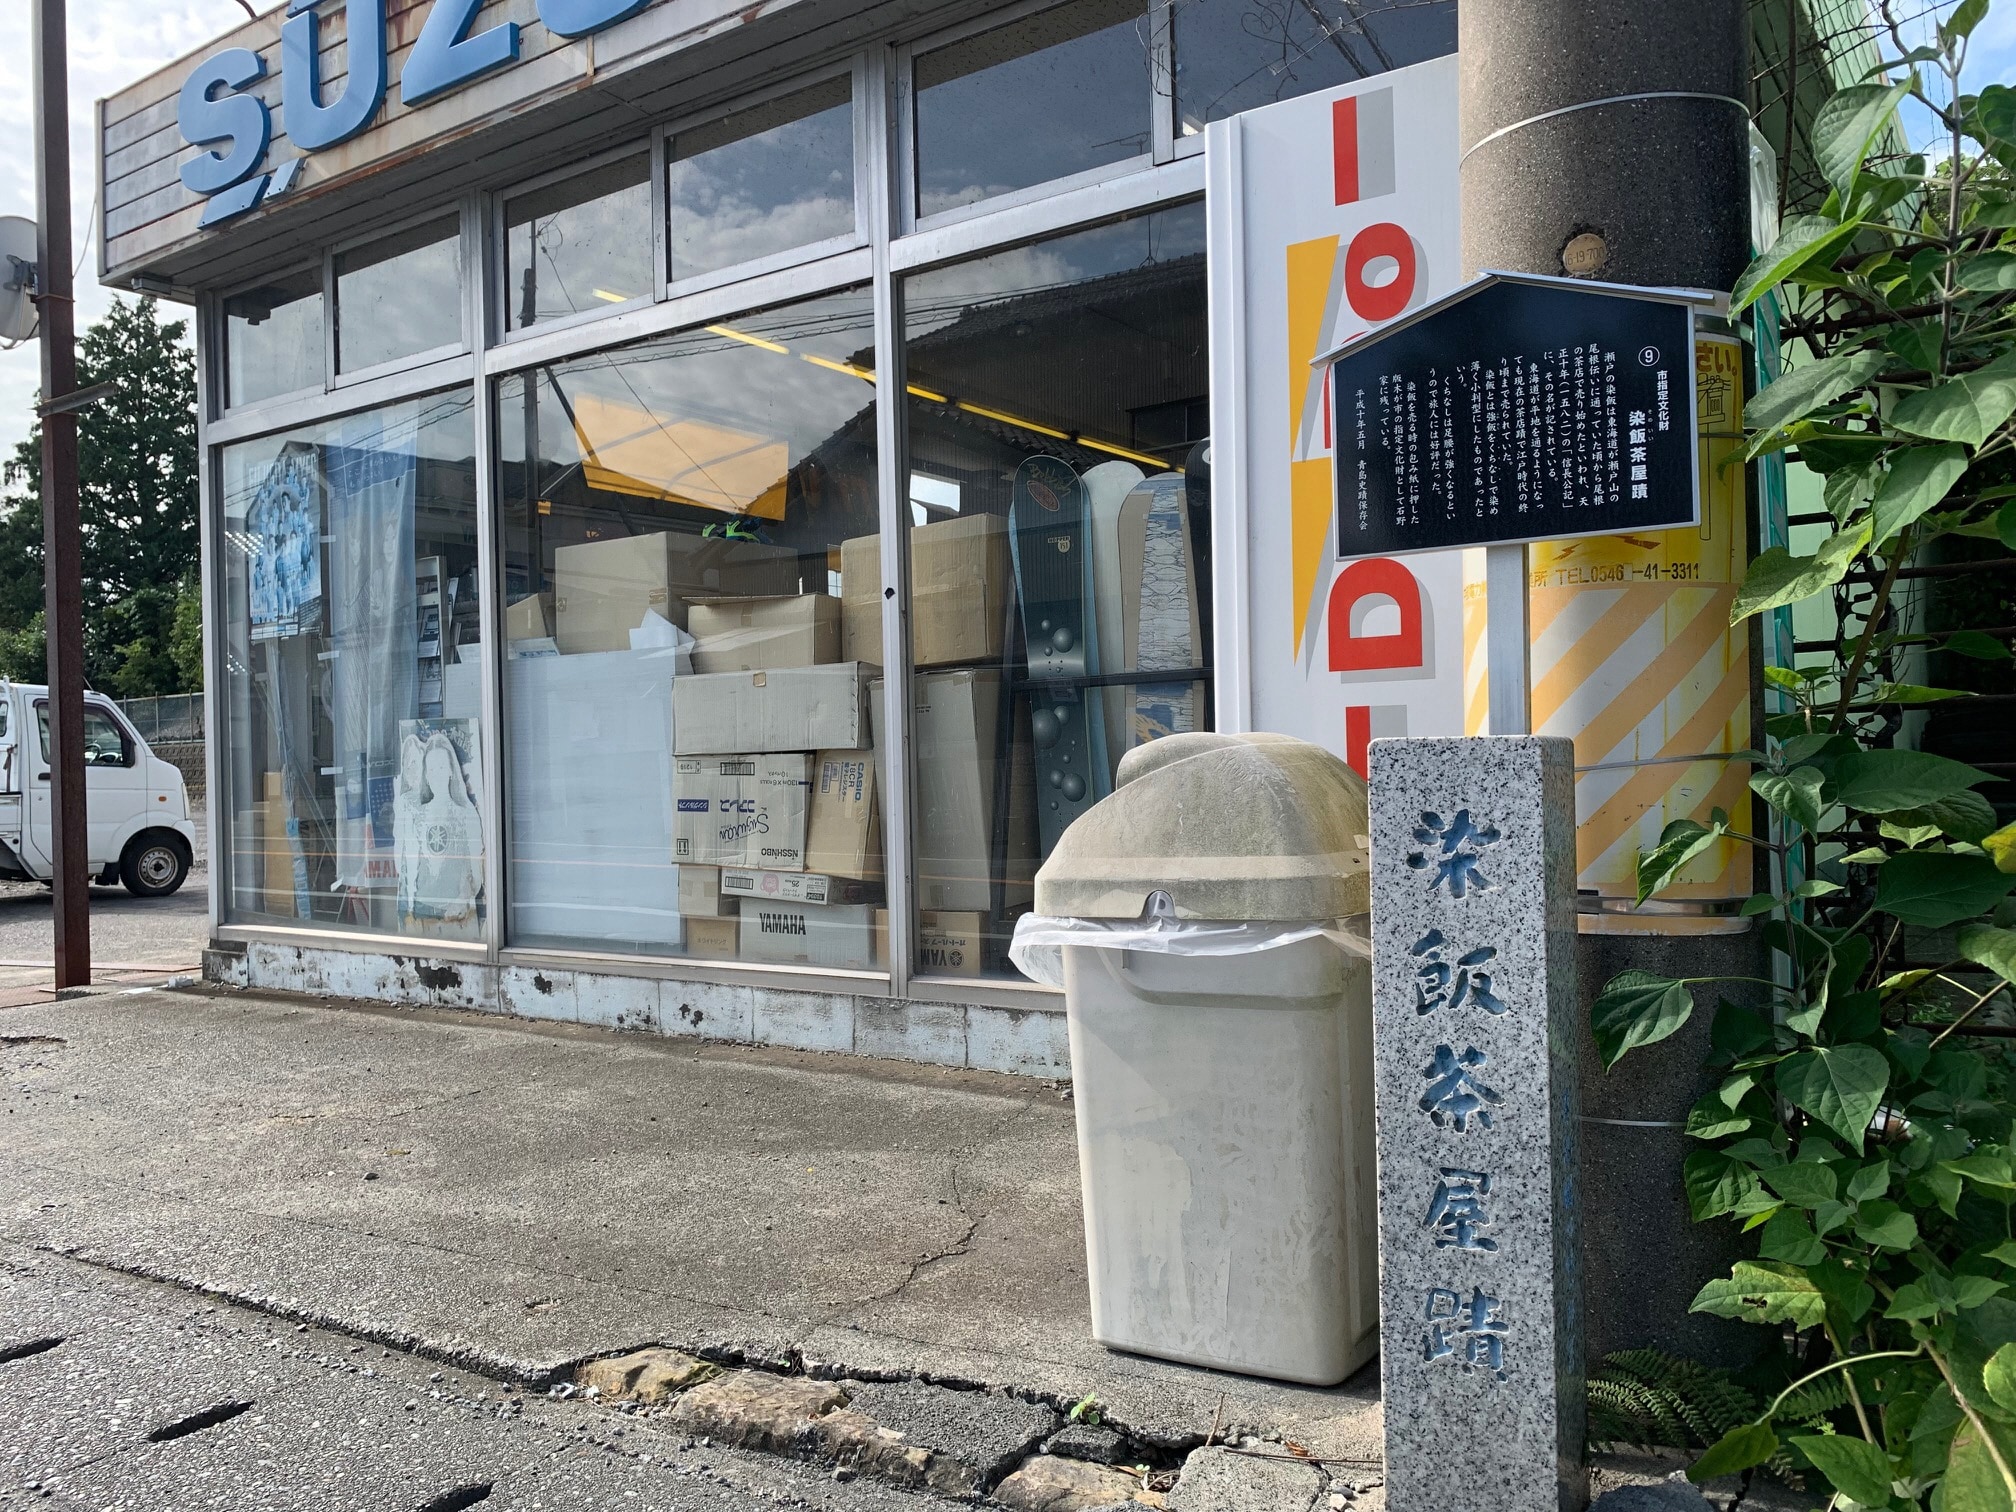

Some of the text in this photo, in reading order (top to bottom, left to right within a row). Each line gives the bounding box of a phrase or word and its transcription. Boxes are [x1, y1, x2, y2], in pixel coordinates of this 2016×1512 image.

[178, 0, 654, 195] SUZ
[1379, 375, 1391, 450] 家に残っている。
[1429, 368, 1442, 495] うので旅人には好評だった。
[1443, 376, 1456, 520] くちなしは足腰が強くなるとい
[1456, 366, 1468, 388] いう。
[1470, 361, 1485, 517] 薄く小判型にしたものであったと
[1485, 370, 1499, 515] 染飯とは強飯をくちなしで染め
[1499, 358, 1513, 465] り頃まで売られていた。
[1529, 363, 1544, 509] 東海道が平地を通るようになっ
[1544, 352, 1558, 482] に、その名が記されている。
[1574, 347, 1590, 506] の茶店で売り始めたといわれ、天
[1588, 344, 1604, 506] 尾根伝いに通っていた頃から尾根
[1604, 352, 1619, 502] 瀬戸の染飯は東海道が瀬戸山の
[1656, 370, 1670, 431] 市指定文化財
[1355, 389, 1368, 531] 平成十年五月 青島史蹟保存会
[1392, 374, 1406, 526] 版木が市の指定文化財として石野
[1406, 381, 1419, 524] 染飯を売る時の包み紙に押した
[1629, 410, 1648, 499] 染飯茶屋蹟
[720, 800, 755, 813] コアレス
[855, 762, 864, 800] CASIO
[759, 912, 806, 936] YAMAHA
[761, 848, 799, 859] NISSHINBO
[1407, 808, 1511, 1385] 染飯茶屋蹟
